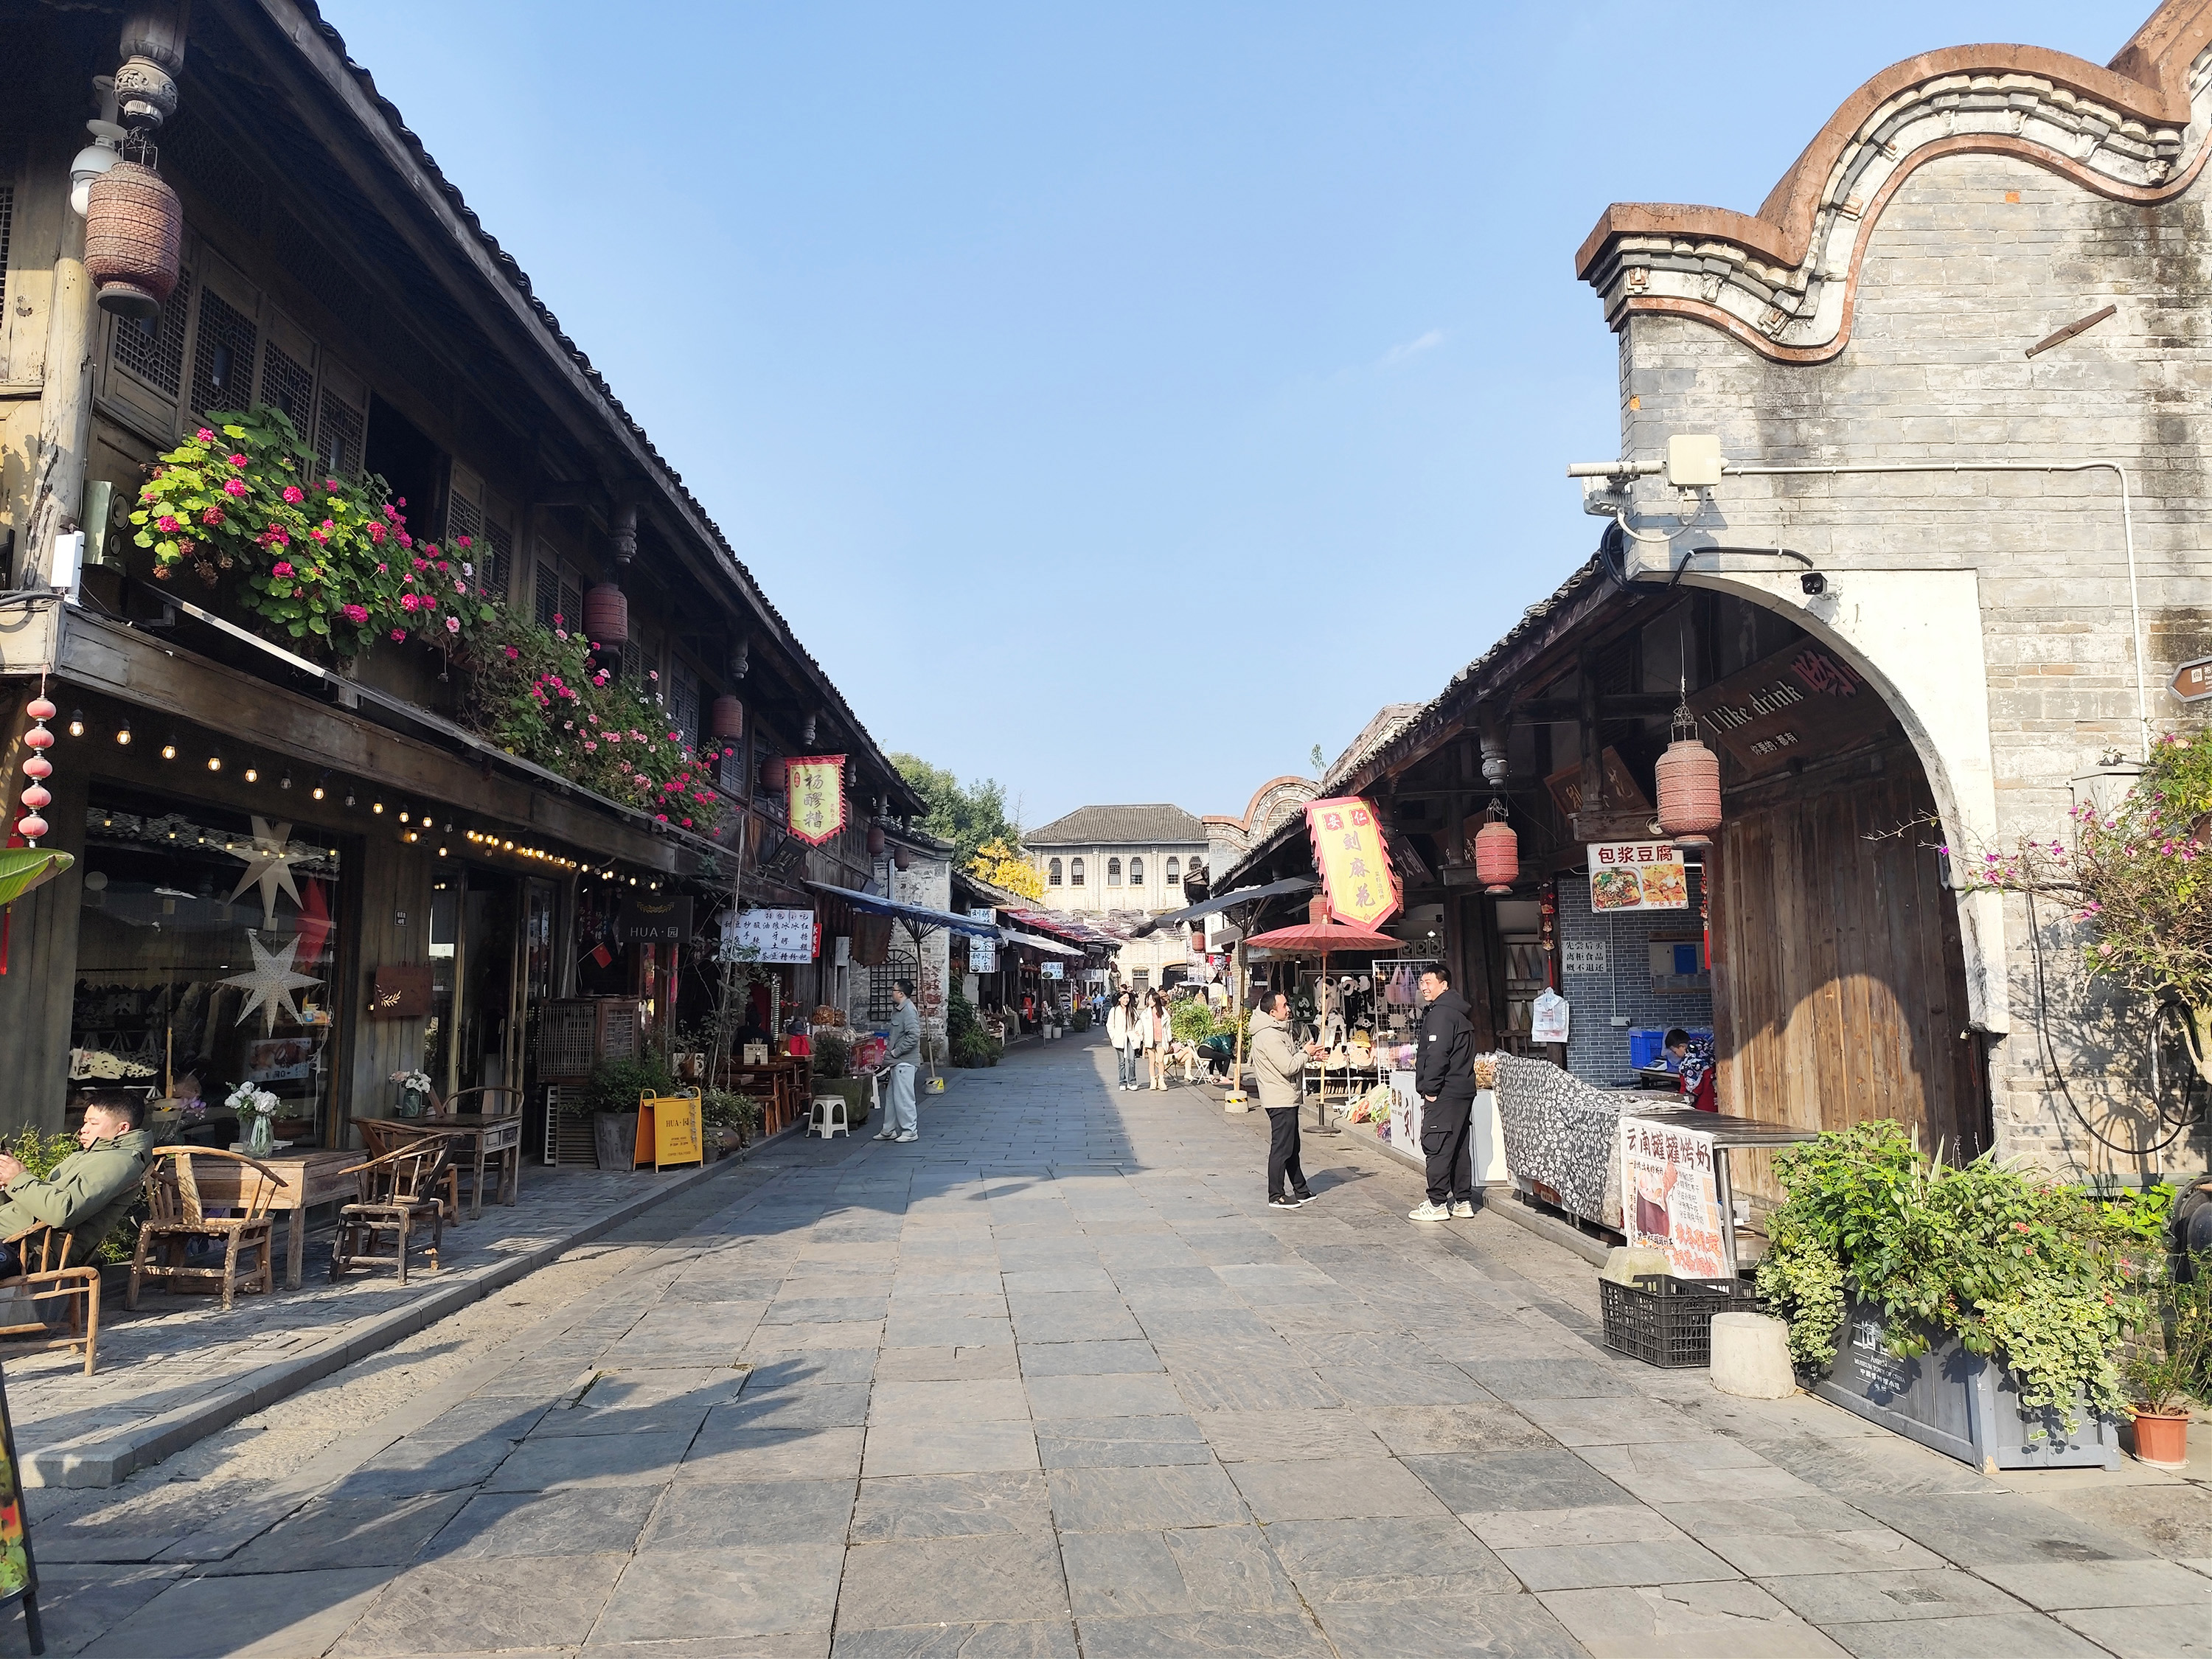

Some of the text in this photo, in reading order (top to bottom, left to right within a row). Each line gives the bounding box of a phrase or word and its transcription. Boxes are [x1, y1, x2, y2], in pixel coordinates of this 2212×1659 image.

[1748, 678, 1806, 716] drink
[1702, 714, 1723, 735] I
[1711, 703, 1754, 730] like
[803, 773, 825, 830] 杨醪糟
[1326, 810, 1368, 830] 安仁
[1598, 844, 1673, 864] 包浆豆腐
[1342, 830, 1377, 908] 刘麻花
[765, 912, 809, 920] 特色小吃
[1565, 941, 1604, 950] 先尝后买
[1566, 952, 1604, 961] 离柜食品
[1566, 963, 1604, 972] 概不退还
[1627, 1127, 1711, 1172] 云南罐罐烤奶
[1854, 1357, 1873, 1371] MUSEUM
[1892, 1374, 1906, 1384] CHINA
